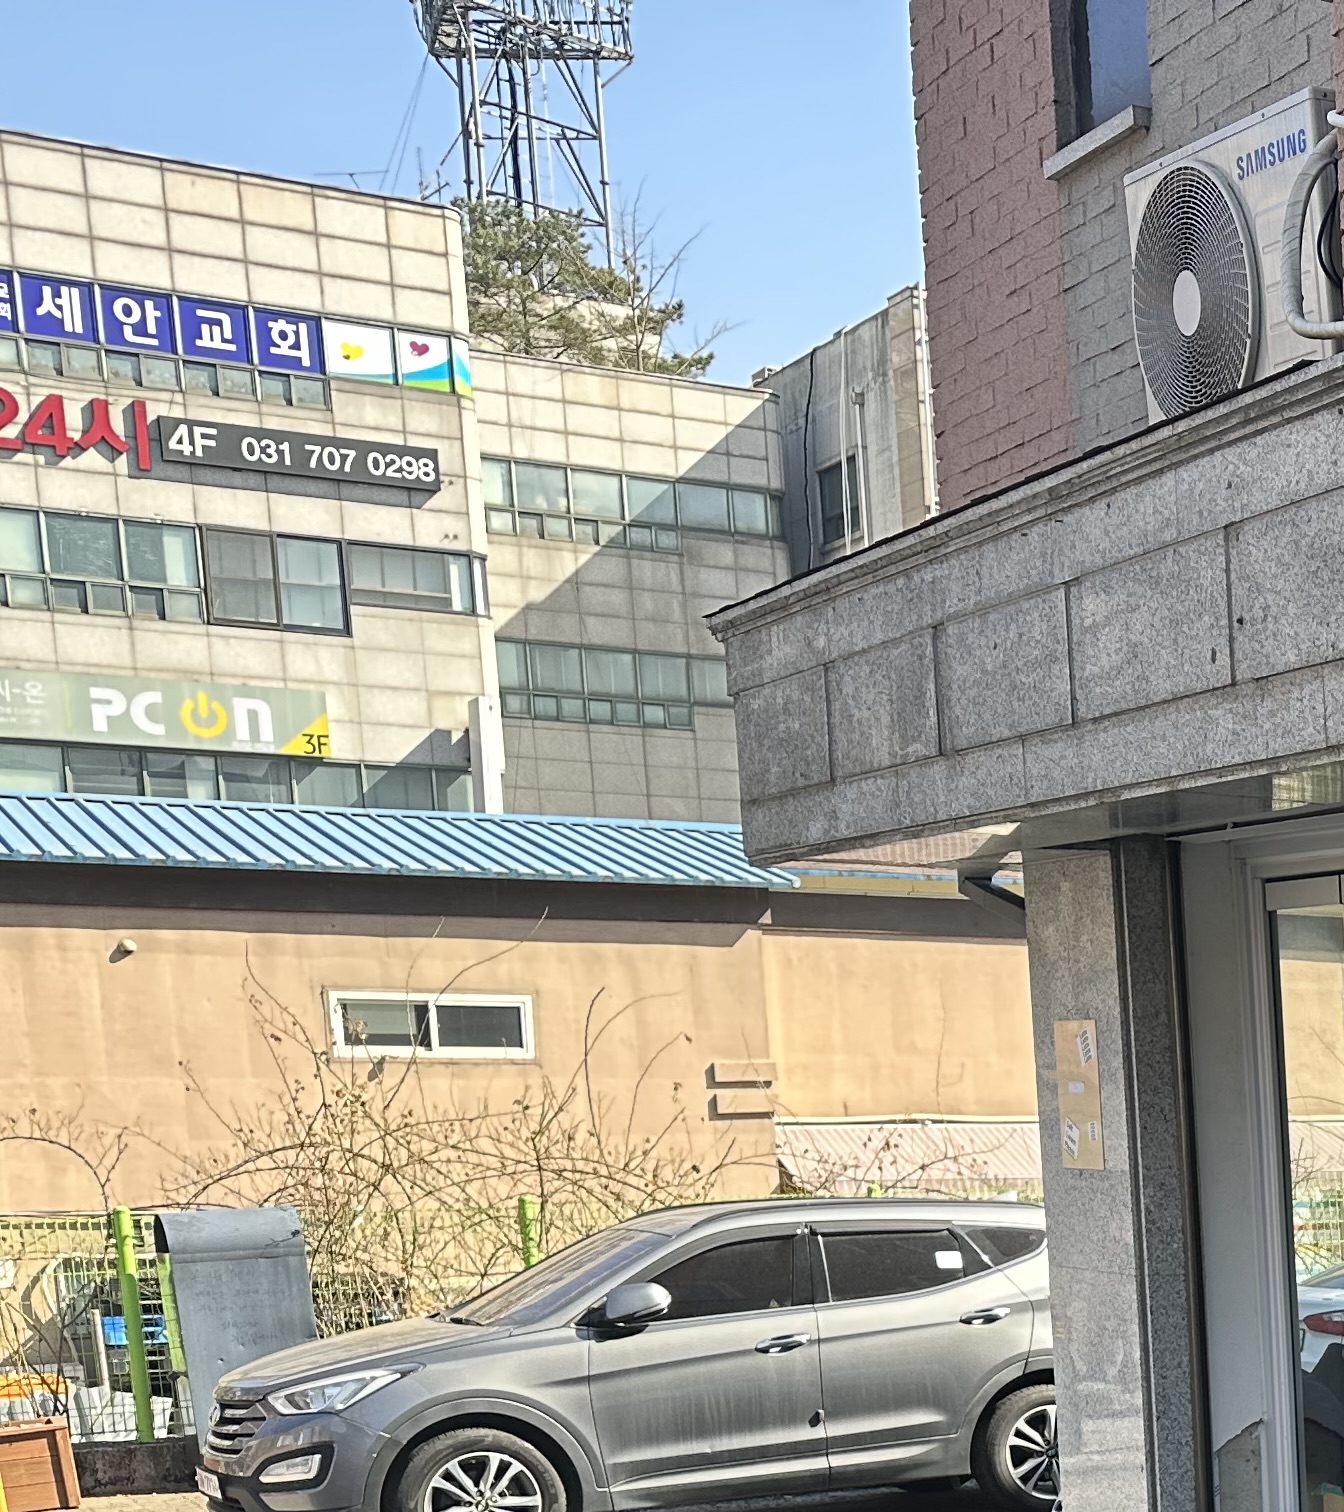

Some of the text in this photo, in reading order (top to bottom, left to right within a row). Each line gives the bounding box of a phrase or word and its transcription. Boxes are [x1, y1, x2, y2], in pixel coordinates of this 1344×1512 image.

[1236, 128, 1307, 181] SAMSUNG
[36, 286, 312, 368] 세안교회
[168, 423, 436, 482] 4F 031 707 0298
[302, 733, 329, 755] 3F
